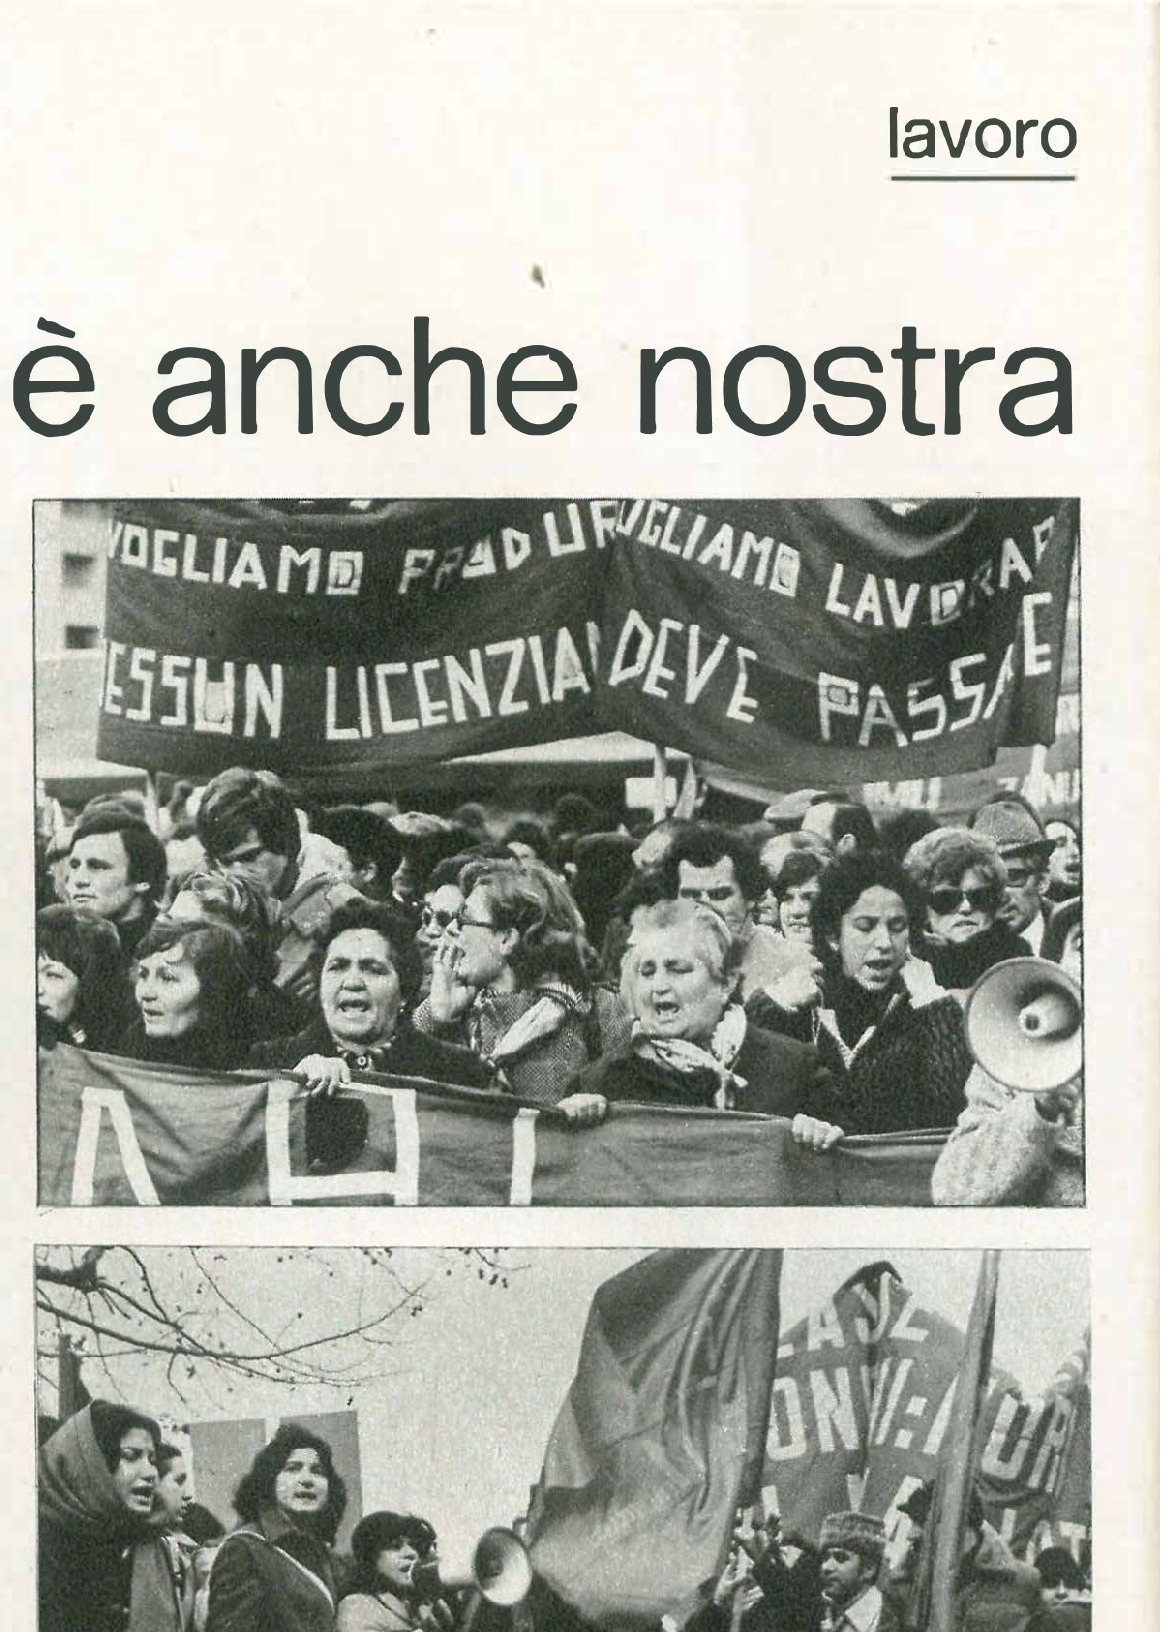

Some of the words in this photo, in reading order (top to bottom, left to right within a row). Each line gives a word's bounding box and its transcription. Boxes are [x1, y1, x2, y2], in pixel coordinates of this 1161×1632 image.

[889, 106, 1078, 159] lavoro
[12, 316, 95, 438] è
[152, 316, 578, 437] anche
[639, 326, 1073, 437] nostra
[608, 608, 758, 723] DEVE
